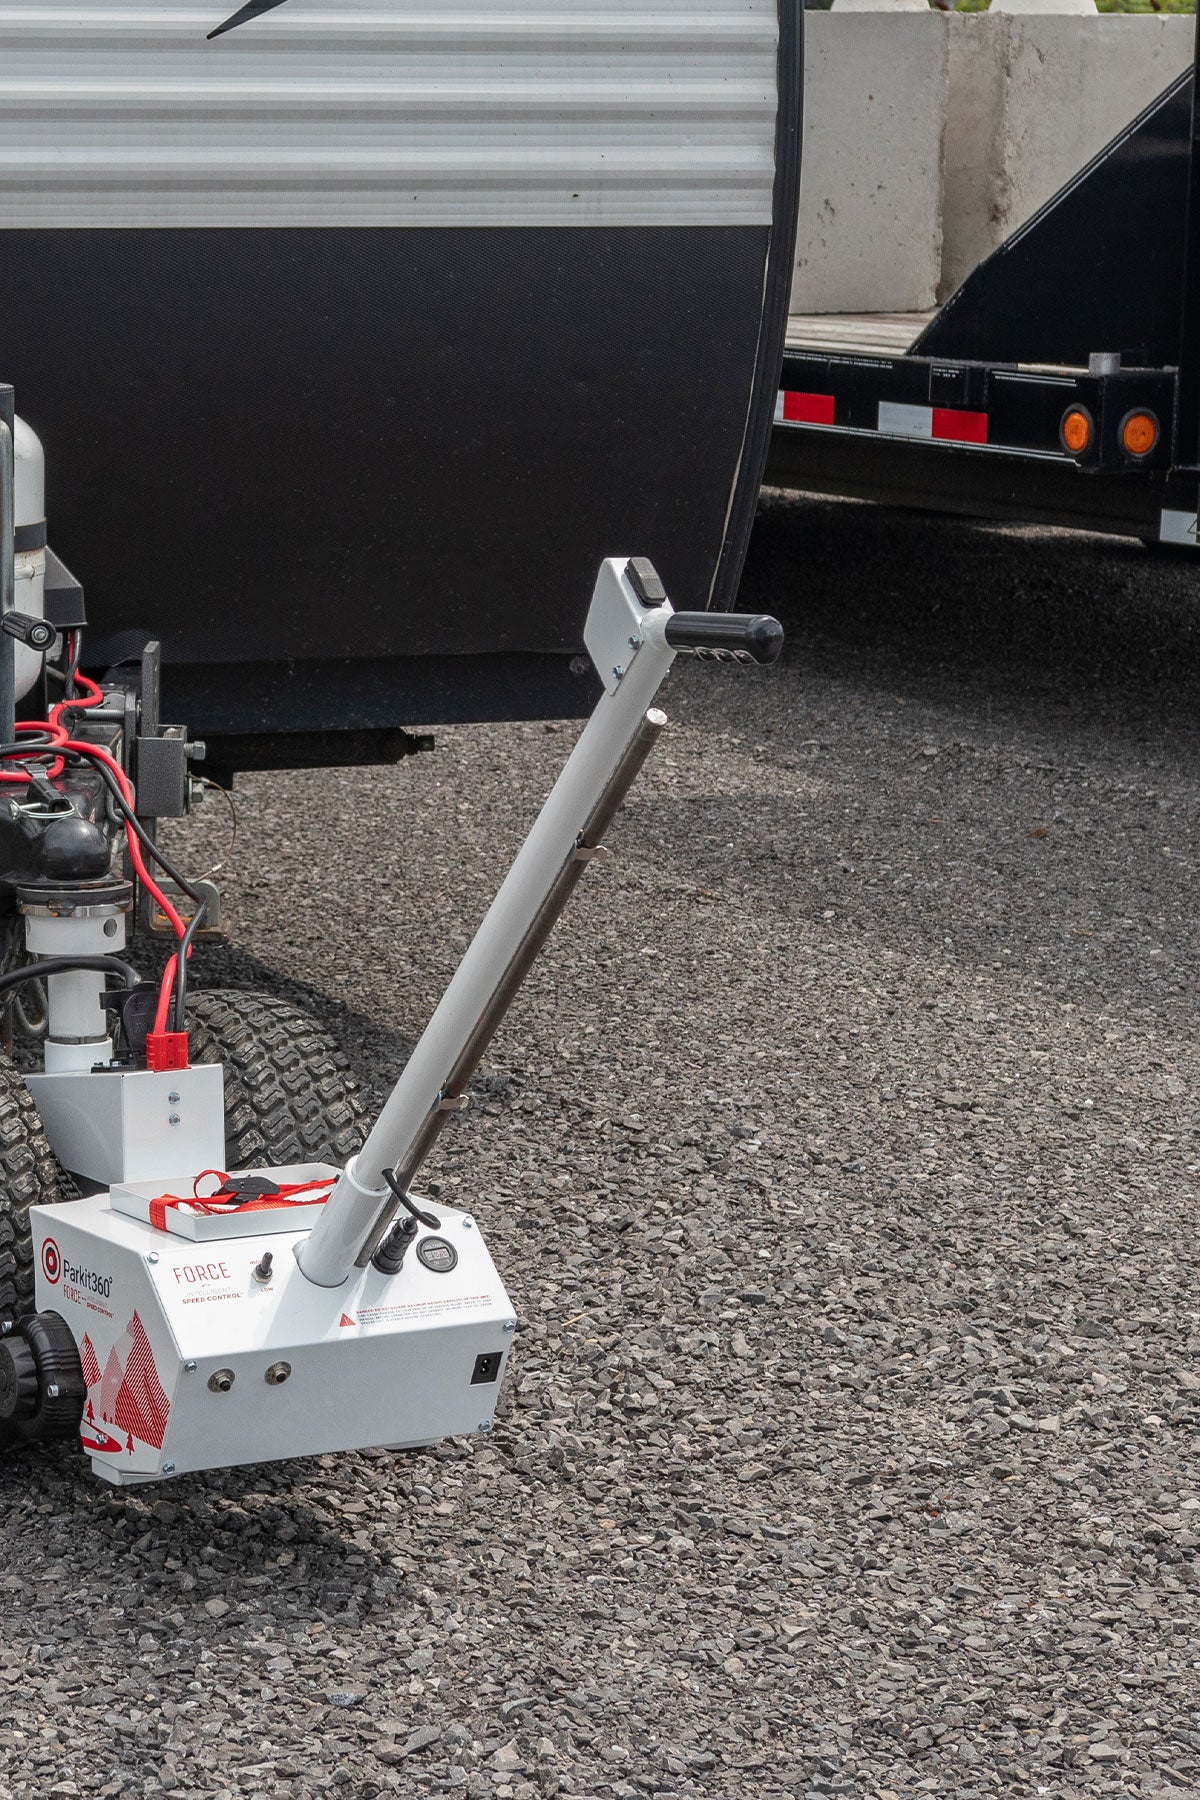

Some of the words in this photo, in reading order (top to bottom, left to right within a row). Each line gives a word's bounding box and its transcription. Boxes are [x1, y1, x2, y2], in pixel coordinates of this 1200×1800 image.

[173, 1262, 232, 1284] FORCE
[64, 1284, 81, 1304] FORCE
[87, 1302, 97, 1311] SPEED
